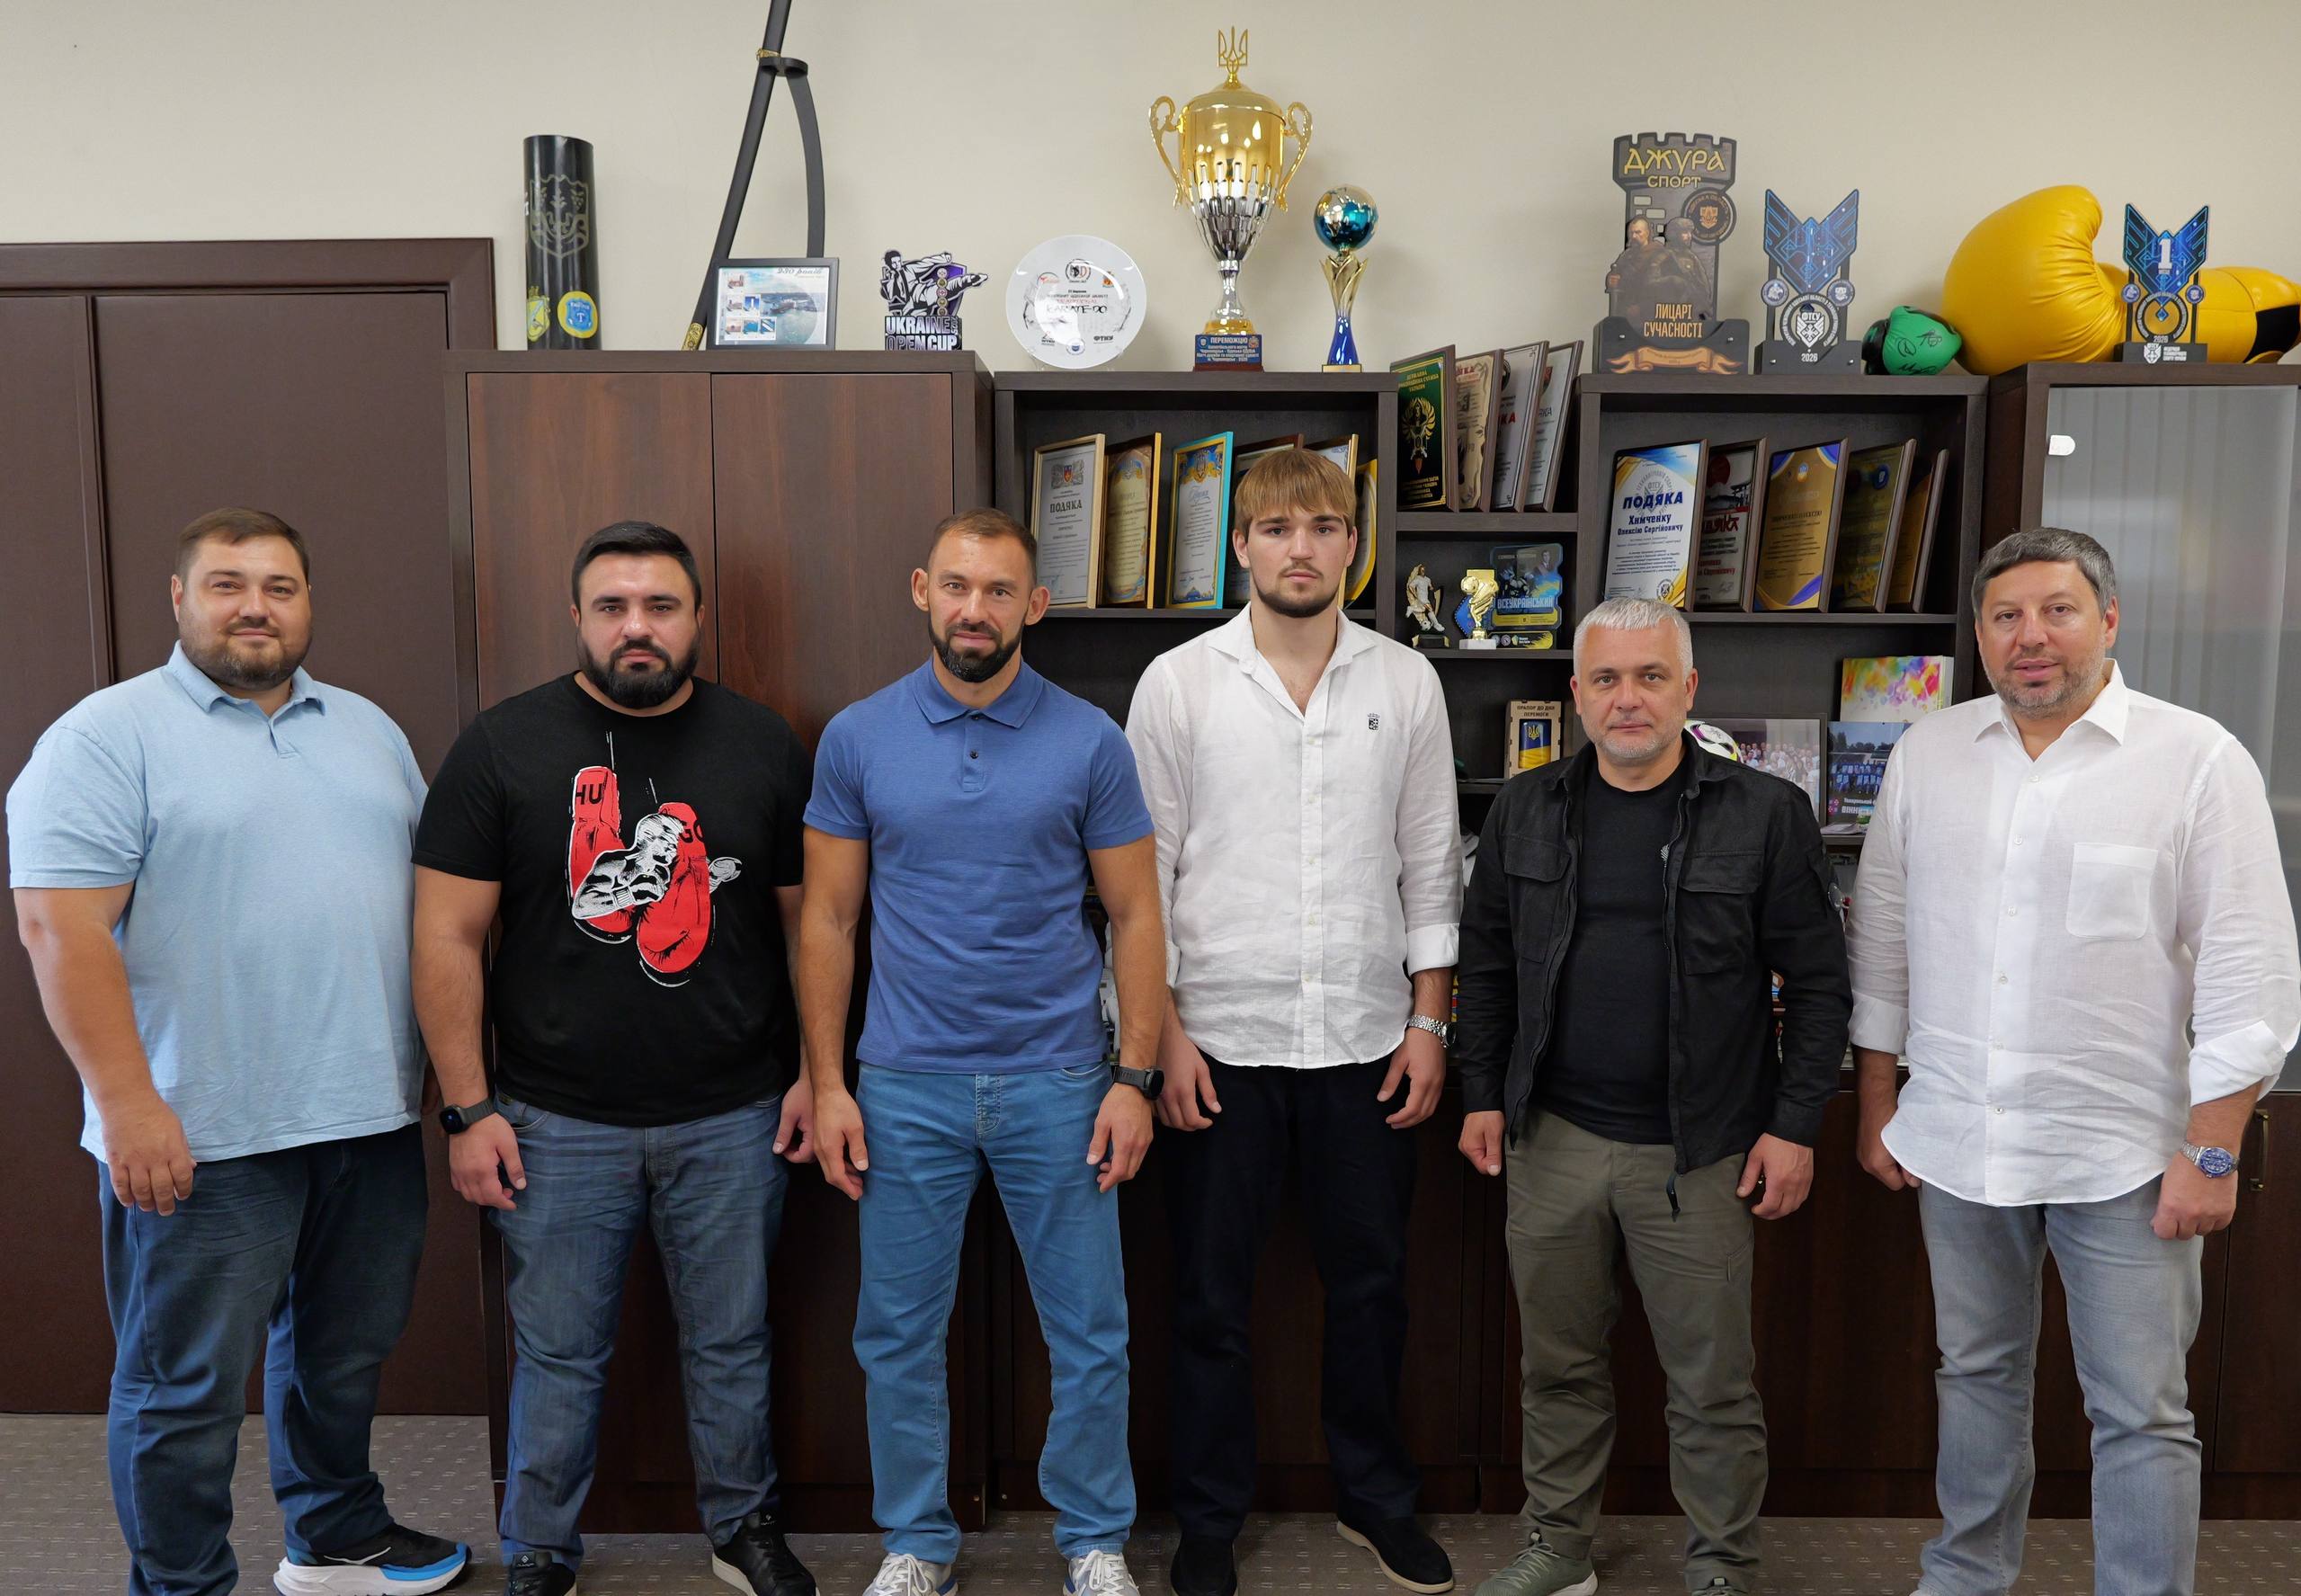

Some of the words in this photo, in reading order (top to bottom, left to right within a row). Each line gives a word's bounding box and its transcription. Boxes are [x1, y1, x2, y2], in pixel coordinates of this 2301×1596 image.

[1624, 147, 1726, 175] ДЖУРА
[1647, 175, 1701, 188] СПОРТ
[1655, 303, 1692, 322] ЛИЦАРІ
[1801, 312, 1821, 321] ФТСУ
[886, 317, 950, 334] UKRAINE
[1644, 321, 1703, 338] СУЧАСНОСТІ
[886, 335, 926, 351] OPEN
[927, 334, 958, 351] CUP
[1049, 500, 1083, 513] ПОДЯКА
[1622, 491, 1683, 510] ПОДЯКА
